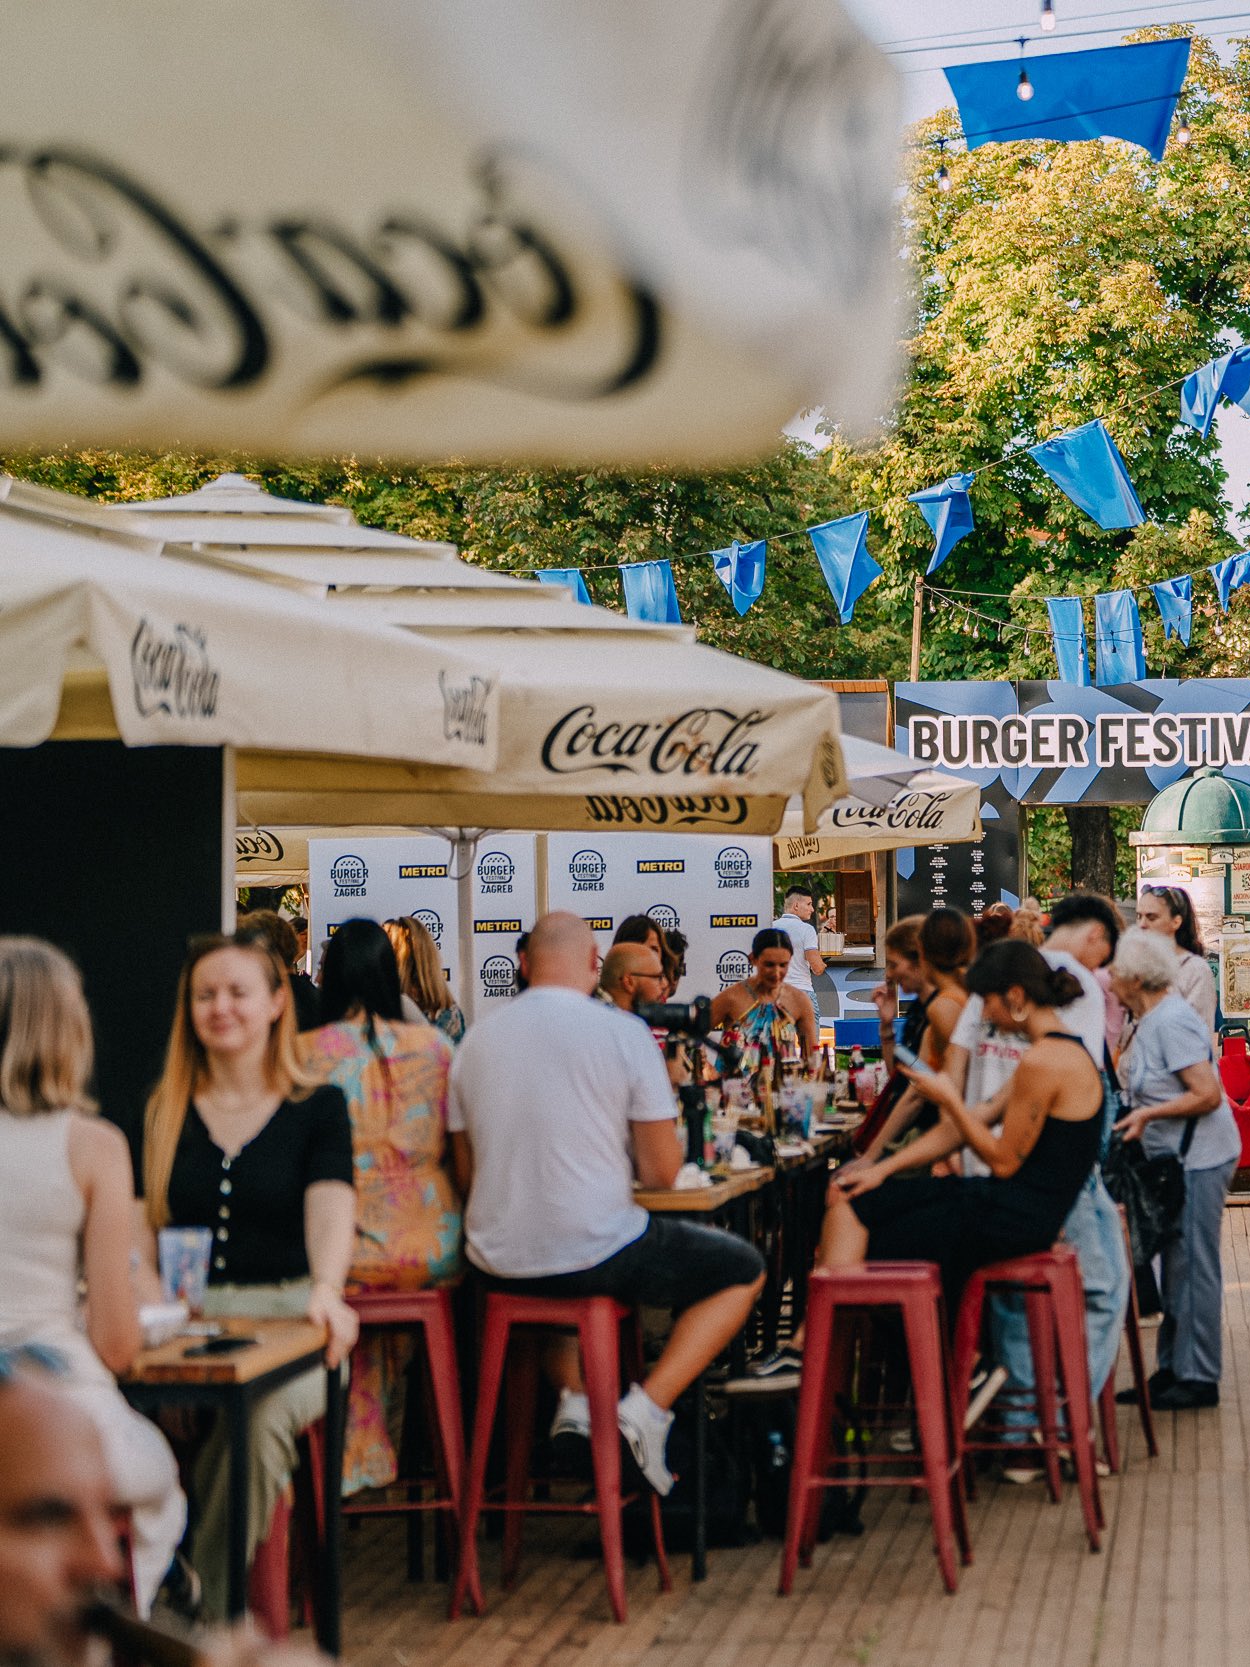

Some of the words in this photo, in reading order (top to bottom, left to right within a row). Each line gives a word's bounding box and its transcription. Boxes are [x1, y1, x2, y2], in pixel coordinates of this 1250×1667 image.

[540, 705, 776, 777] Coca-Cola
[912, 715, 1087, 766] BURGER
[477, 865, 515, 876] BURGER
[569, 863, 607, 874] BURGER
[639, 861, 683, 872] METRO
[714, 860, 752, 871] BURGER
[330, 868, 369, 879] BURGER
[401, 866, 446, 877] METRO
[480, 884, 513, 894] ZAGREB
[572, 882, 605, 892] ZAGREB
[717, 879, 750, 889] ZAGREB
[334, 888, 367, 898] ZAGREB
[476, 921, 520, 932] METRO
[586, 919, 612, 930] TRO
[712, 916, 756, 927] METRO
[716, 963, 754, 974] BURGER
[480, 969, 518, 980] BURGER
[483, 988, 516, 998] ZAGREB
